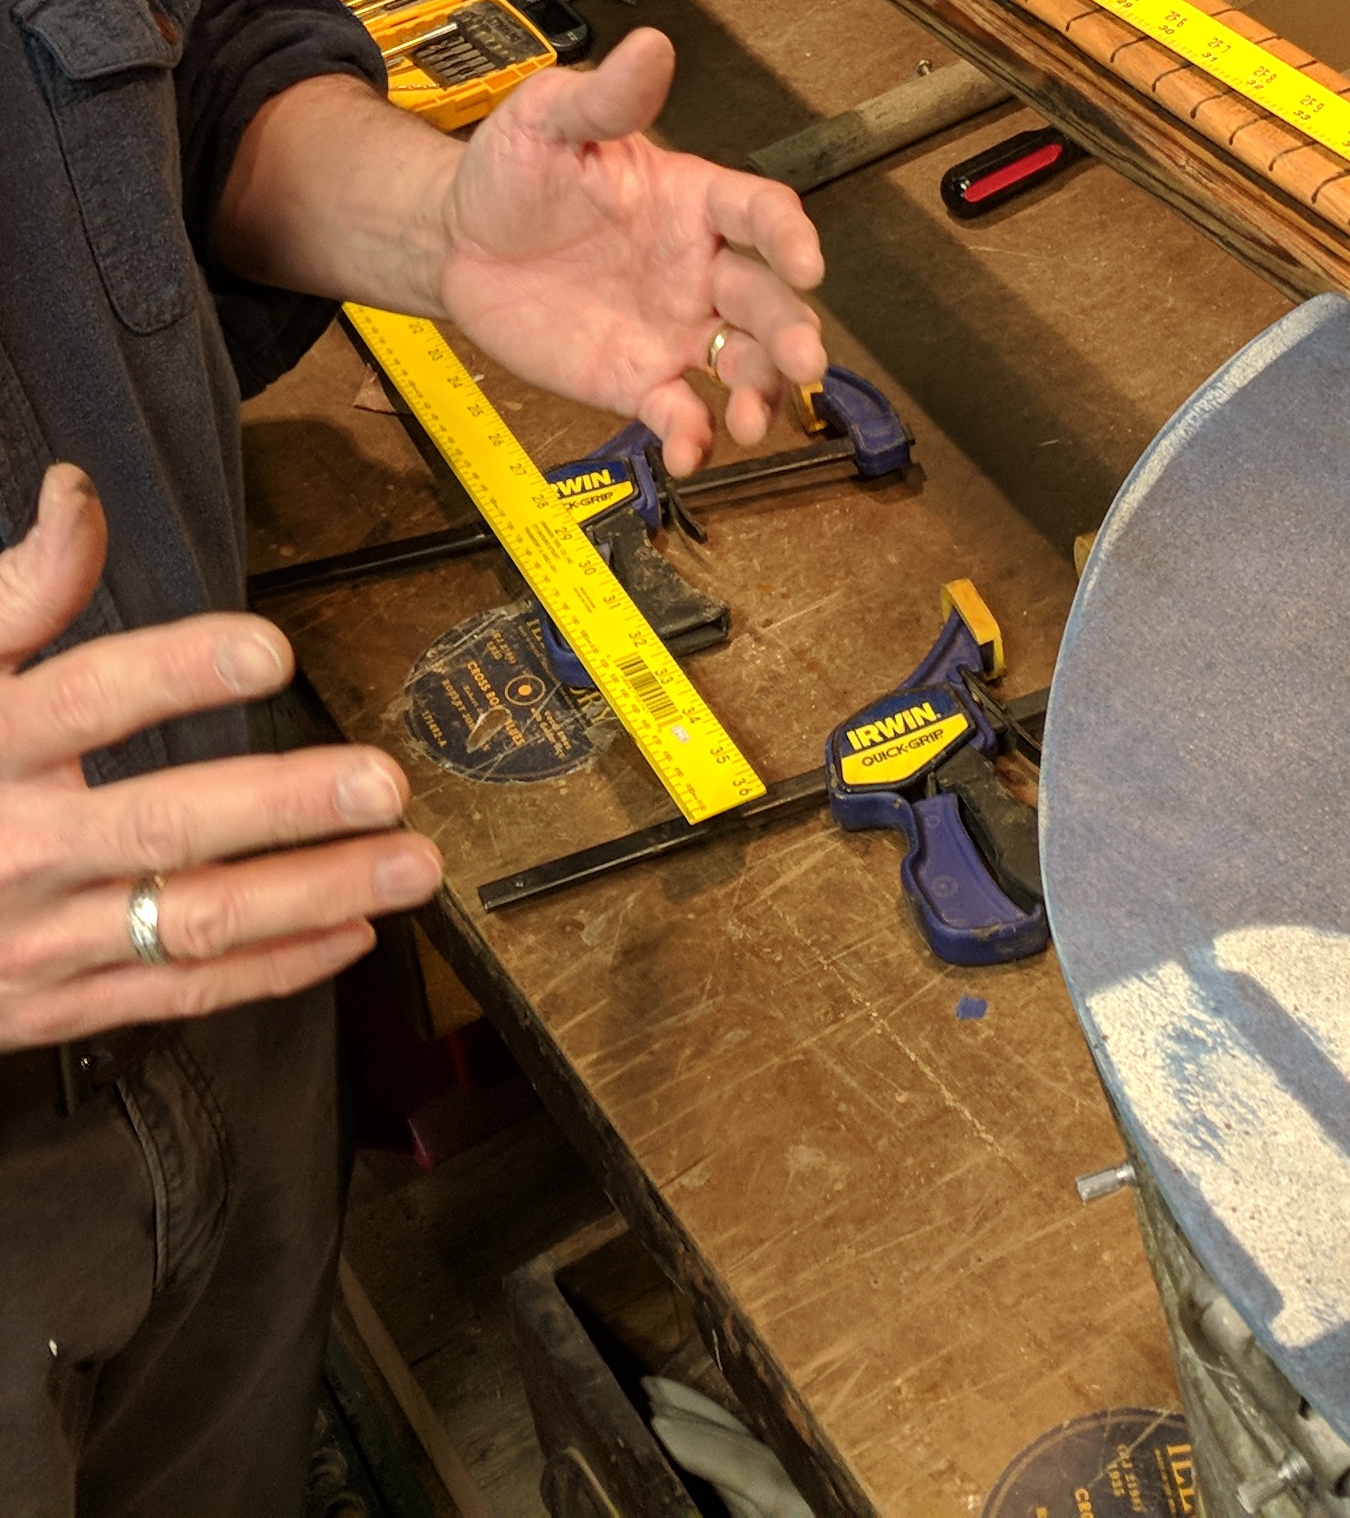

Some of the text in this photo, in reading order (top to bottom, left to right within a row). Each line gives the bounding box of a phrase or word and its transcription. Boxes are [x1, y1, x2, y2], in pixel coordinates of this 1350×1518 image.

[1158, 24, 1175, 36] 30
[1201, 51, 1218, 63] 31
[1246, 79, 1265, 91] 32
[1293, 109, 1312, 121] 33
[427, 348, 443, 361] 23
[447, 375, 463, 389] 24
[467, 403, 484, 417] 25
[488, 433, 505, 447] 26
[510, 463, 527, 477] 27
[532, 494, 549, 509] 28
[554, 526, 573, 541] 29
[578, 561, 597, 576] 30
[603, 595, 621, 610] 31
[628, 631, 648, 648] 32
[465, 659, 491, 692] CROSS
[654, 668, 674, 685] 33
[682, 706, 701, 725] 34
[846, 702, 938, 751] IRWIN
[709, 747, 730, 765] 35
[732, 778, 753, 797] 36
